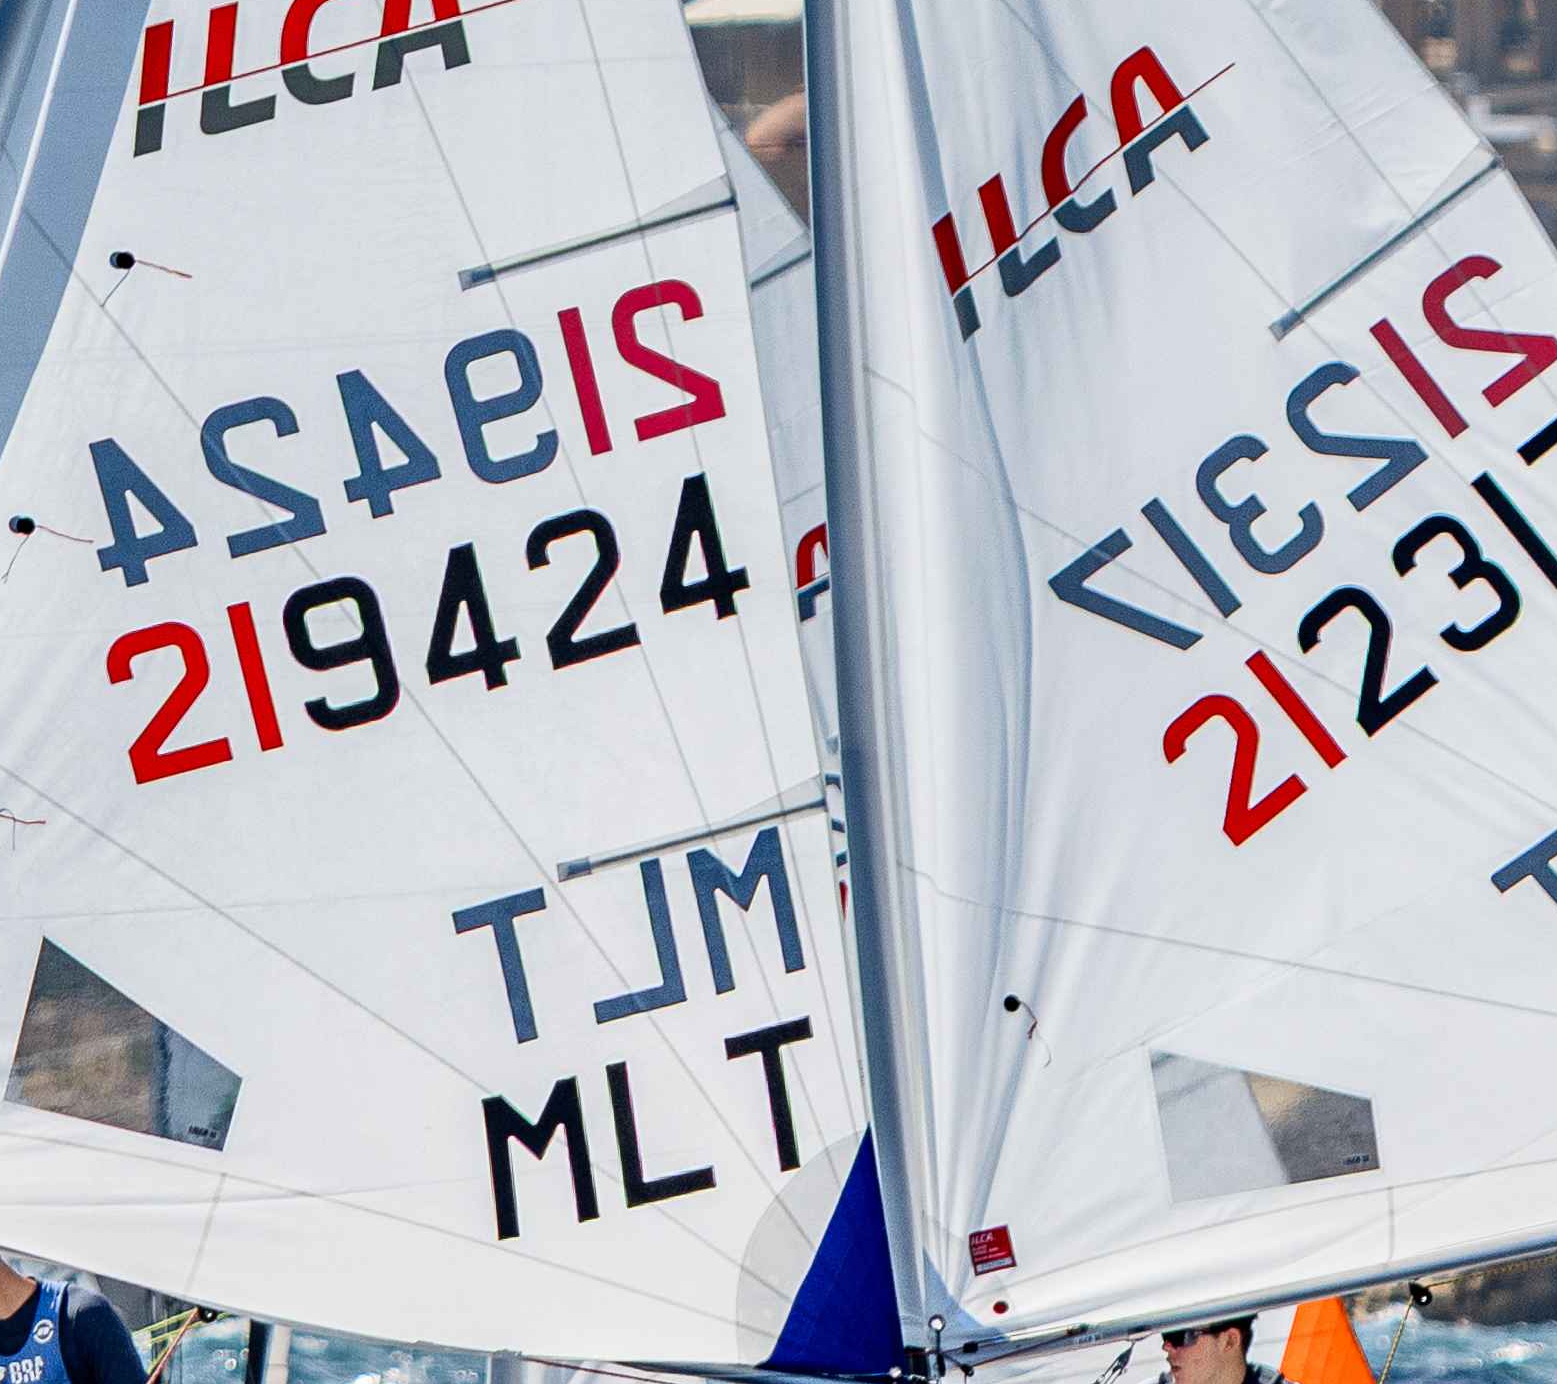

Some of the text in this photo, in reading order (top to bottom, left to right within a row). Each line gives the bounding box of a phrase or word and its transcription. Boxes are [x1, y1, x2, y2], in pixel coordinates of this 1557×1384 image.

[932, 46, 1209, 340] ILCA
[105, 474, 750, 784] 219424
[482, 1017, 814, 1241] MLT
